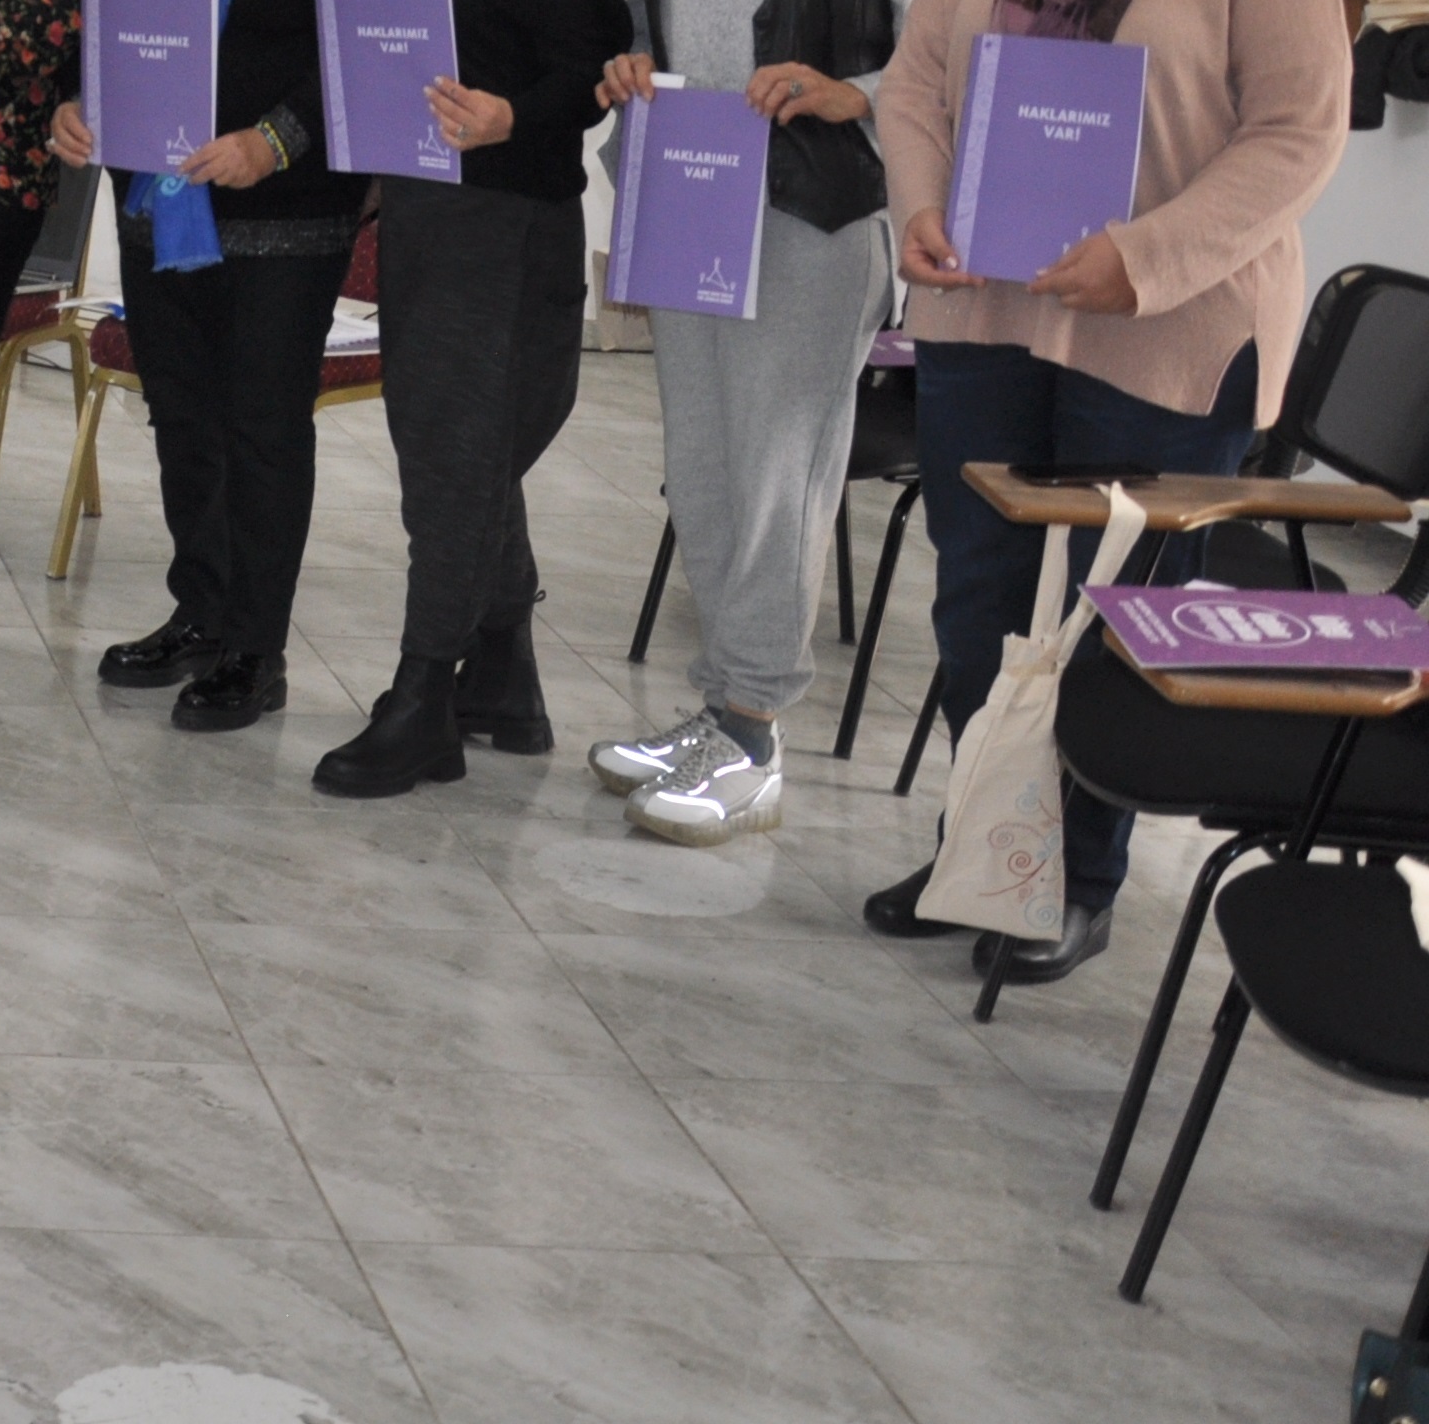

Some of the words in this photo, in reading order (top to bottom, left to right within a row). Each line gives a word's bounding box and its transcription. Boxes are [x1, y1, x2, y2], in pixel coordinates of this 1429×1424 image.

[118, 32, 190, 48] HAKLARIMIZ
[357, 26, 429, 41] HAKLARIMIZ
[138, 47, 168, 60] VAR!
[379, 41, 409, 53] VAR!
[1017, 104, 1111, 127] HAKLARIMIZ
[1043, 124, 1081, 141] VAR!
[663, 148, 740, 168] HAKLARIMIZ
[684, 166, 715, 180] VAR!
